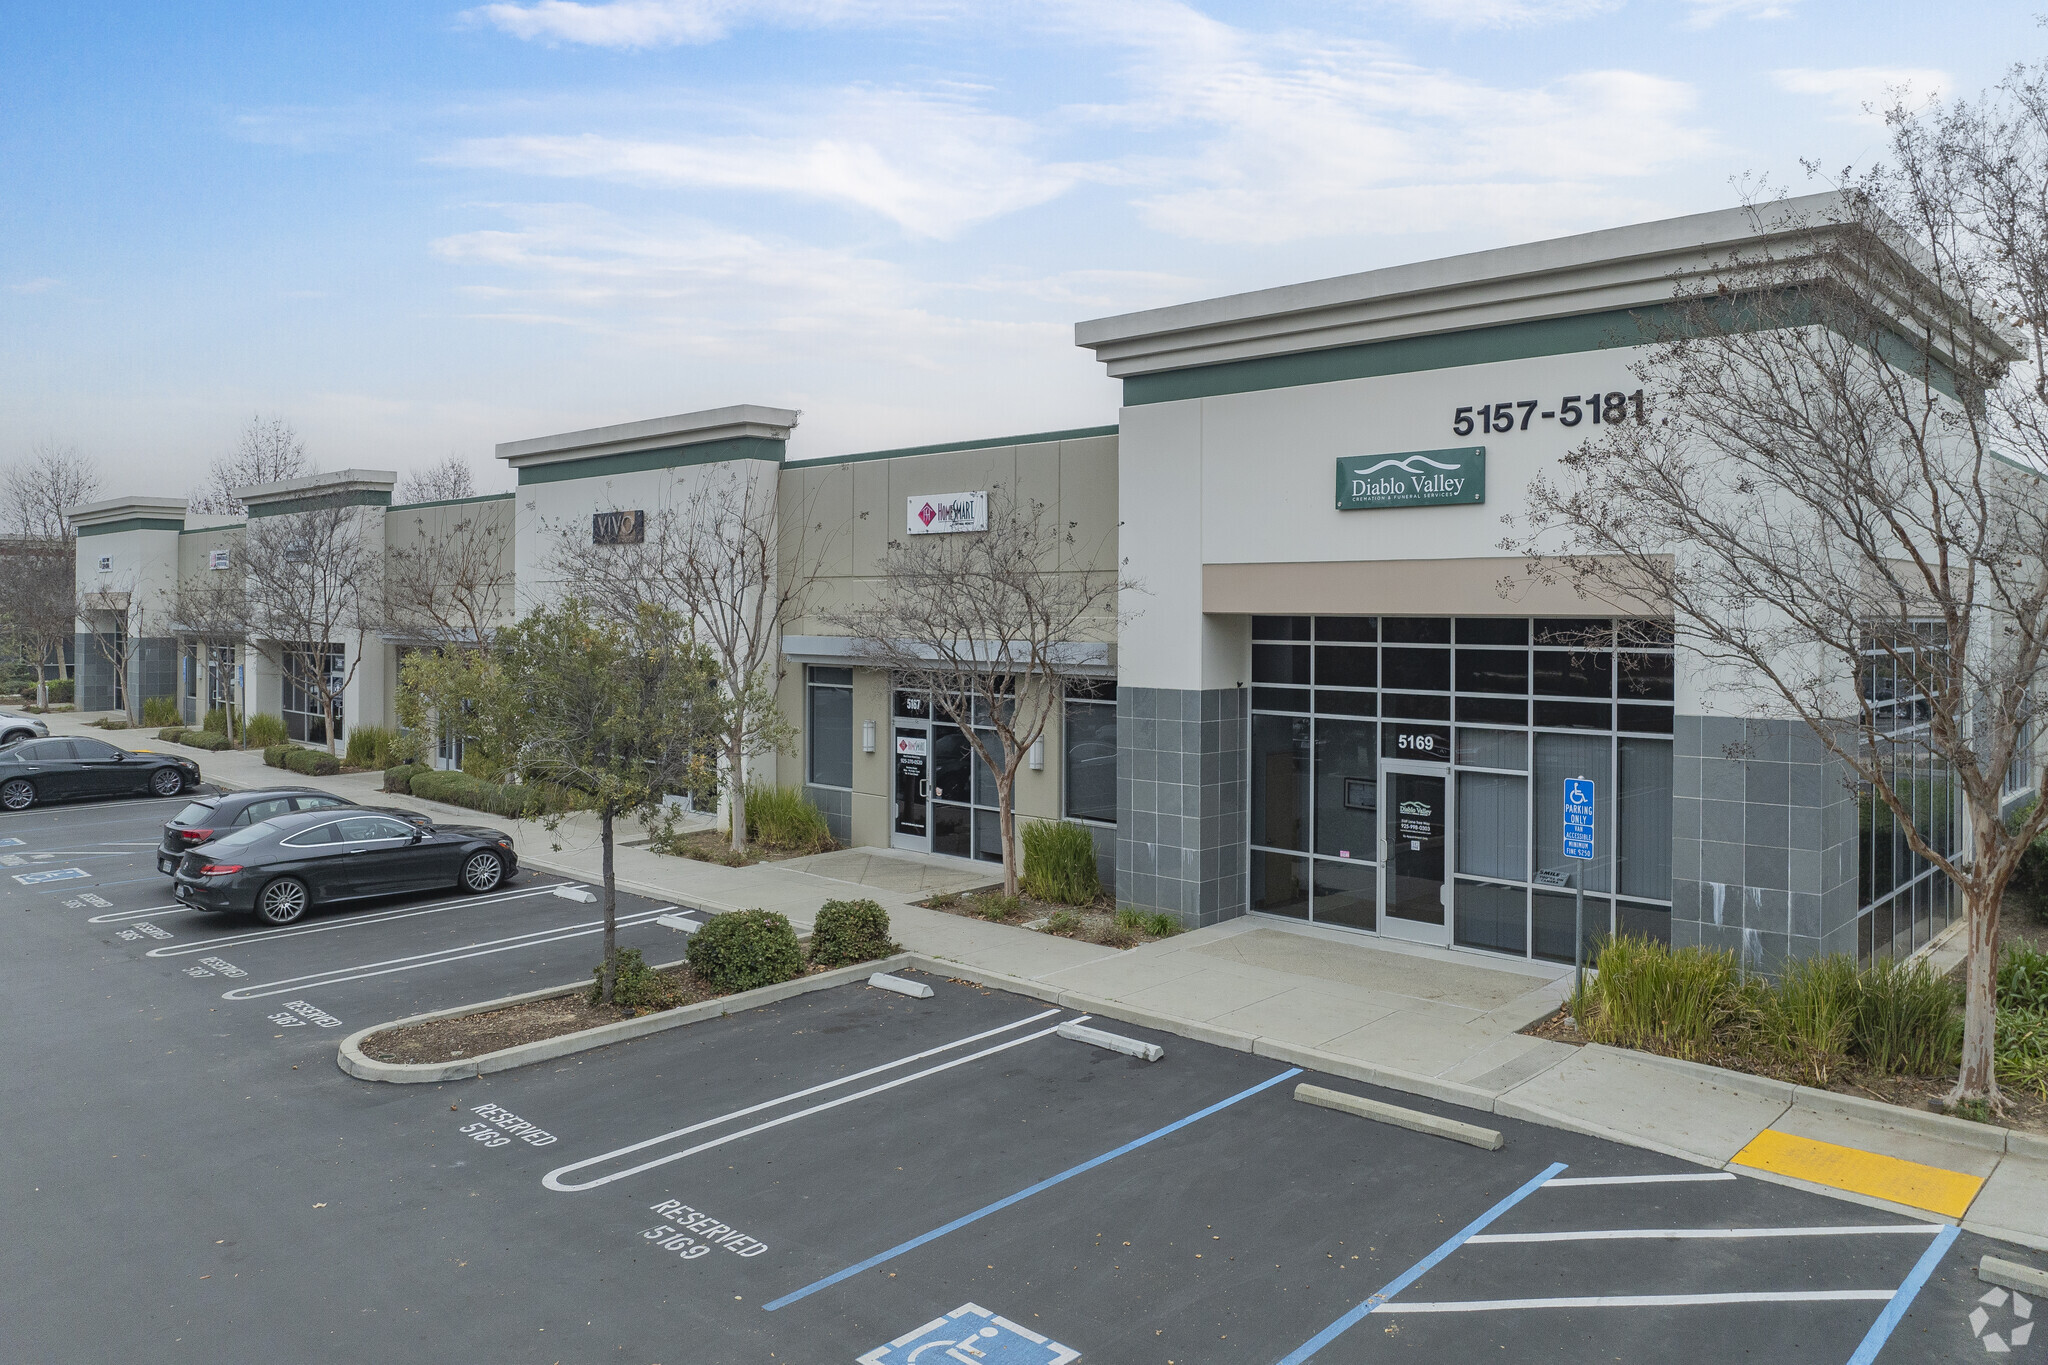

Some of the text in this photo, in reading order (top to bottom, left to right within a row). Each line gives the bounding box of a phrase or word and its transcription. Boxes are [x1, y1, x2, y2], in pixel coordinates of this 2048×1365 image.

[1453, 389, 1646, 436] 5157-5181
[1352, 474, 1465, 497] Diablo Valley
[906, 698, 920, 710] 5167
[1398, 734, 1433, 751] 5169
[1565, 803, 1593, 816] PARKING
[1571, 814, 1587, 825] ONLY
[1566, 831, 1592, 841] ACCESSIBLE
[1568, 840, 1589, 849] MINIMUM
[1566, 847, 1591, 857] FINE $250
[1539, 869, 1560, 877] SMILE
[131, 921, 174, 940] RESERVED
[181, 965, 216, 978] 5167
[198, 956, 248, 978] RESERVED
[267, 1011, 307, 1028] 5167
[282, 1000, 343, 1028] RESERVED
[470, 1102, 557, 1147] RESERVED
[459, 1121, 511, 1148] 5169
[650, 1199, 769, 1258] RESERVED
[643, 1225, 711, 1260] 5169
